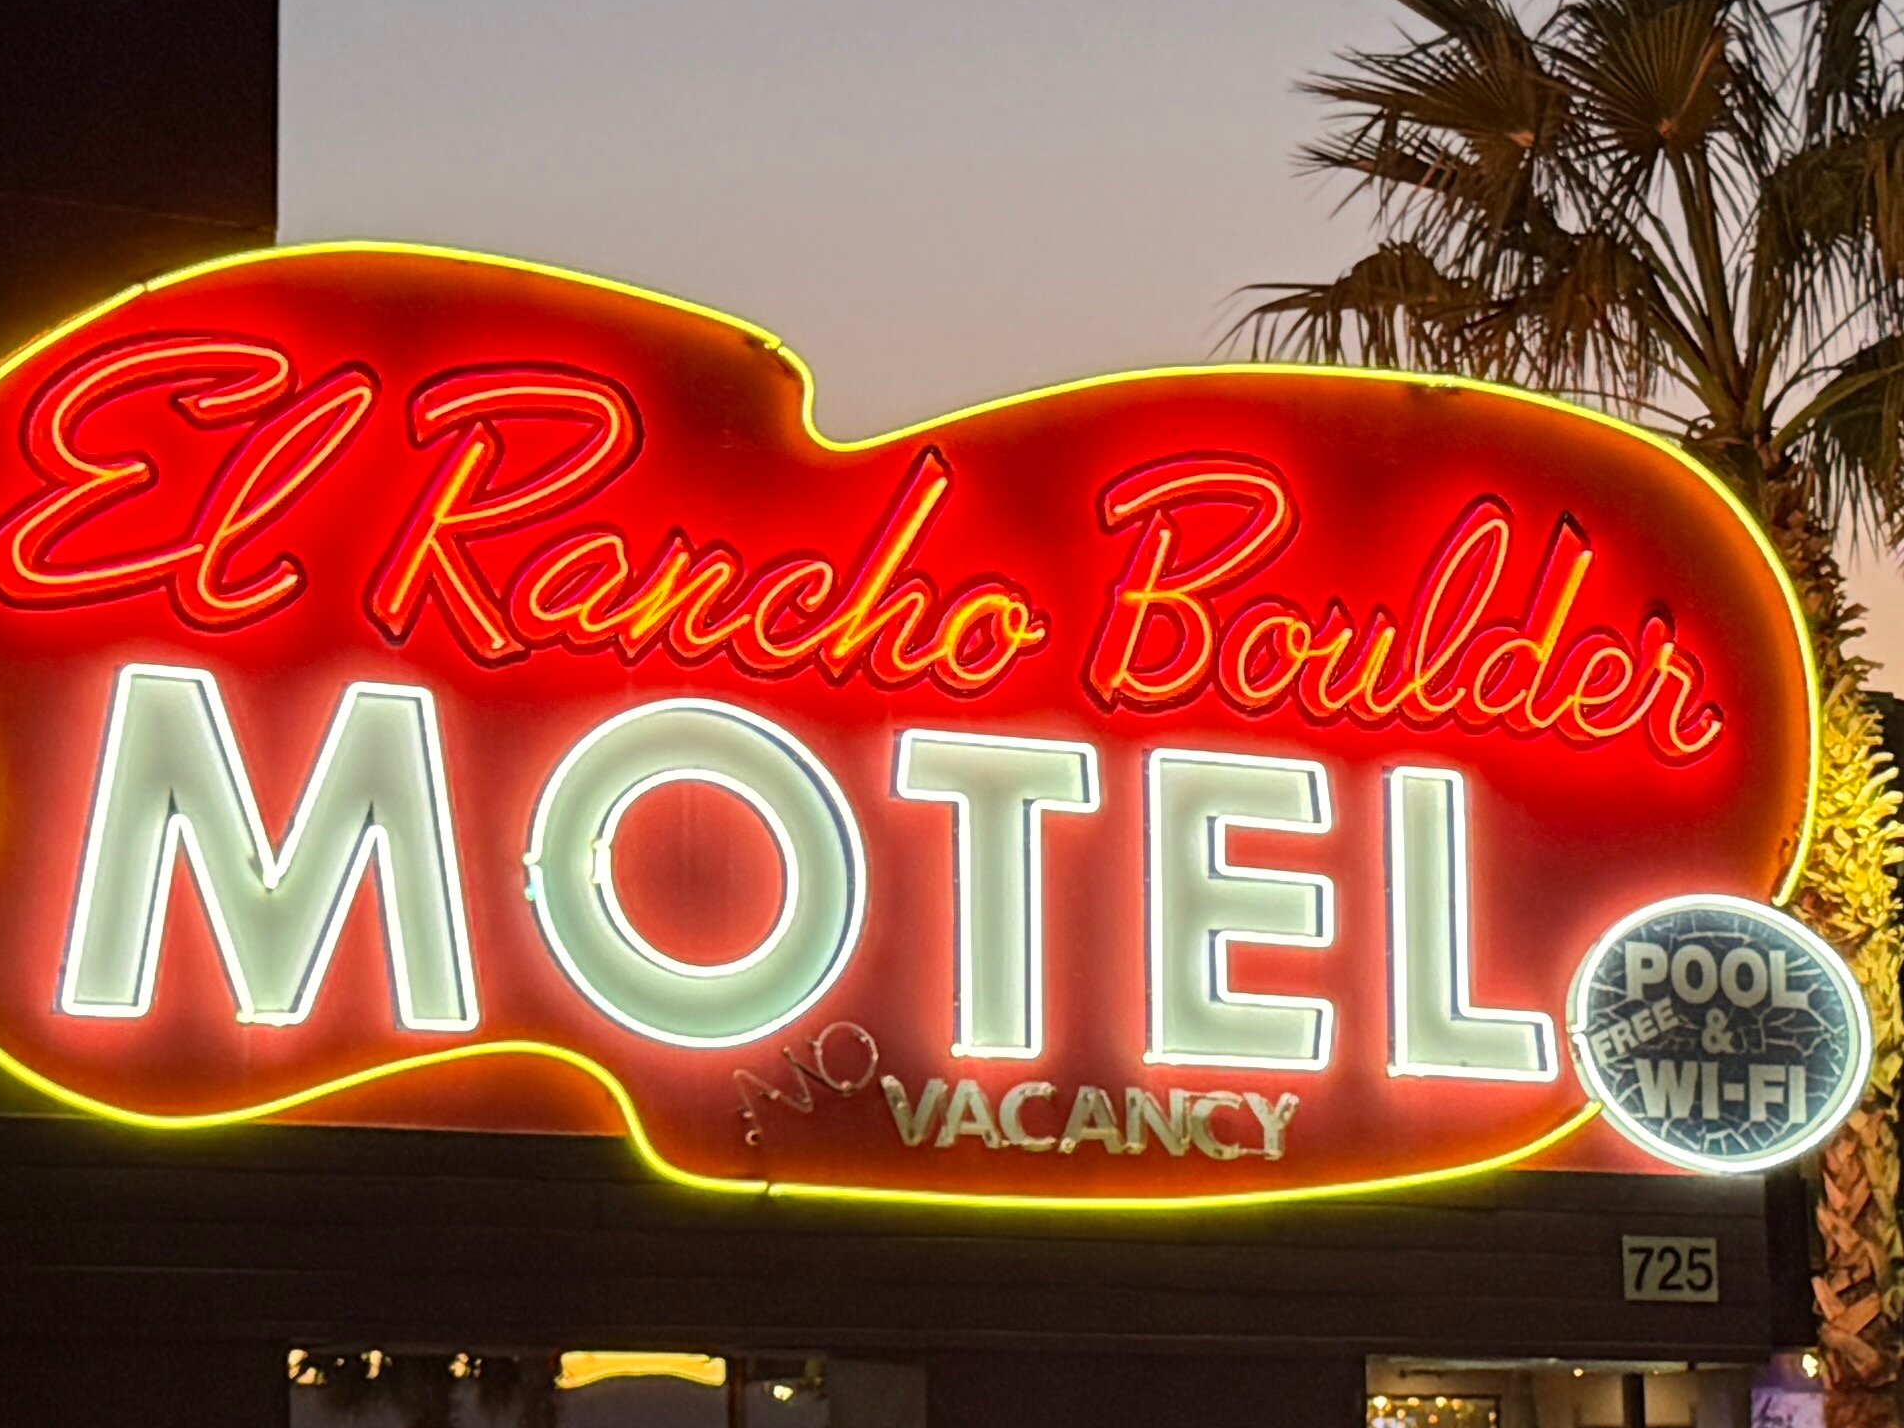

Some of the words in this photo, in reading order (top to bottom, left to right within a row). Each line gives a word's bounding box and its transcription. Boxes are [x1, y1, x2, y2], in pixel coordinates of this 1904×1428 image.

[365, 359, 1049, 692] Rancho
[1085, 448, 1726, 766] Boulder
[57, 661, 1558, 1082] MOTEL
[1625, 940, 1809, 1010] POOL
[1590, 996, 1680, 1068] FREE
[1701, 1007, 1735, 1055] &
[734, 1021, 879, 1147] NO
[881, 1074, 1299, 1161] VACANCY
[1634, 1058, 1808, 1124] WI-FI
[1628, 1247, 1715, 1293] 725
